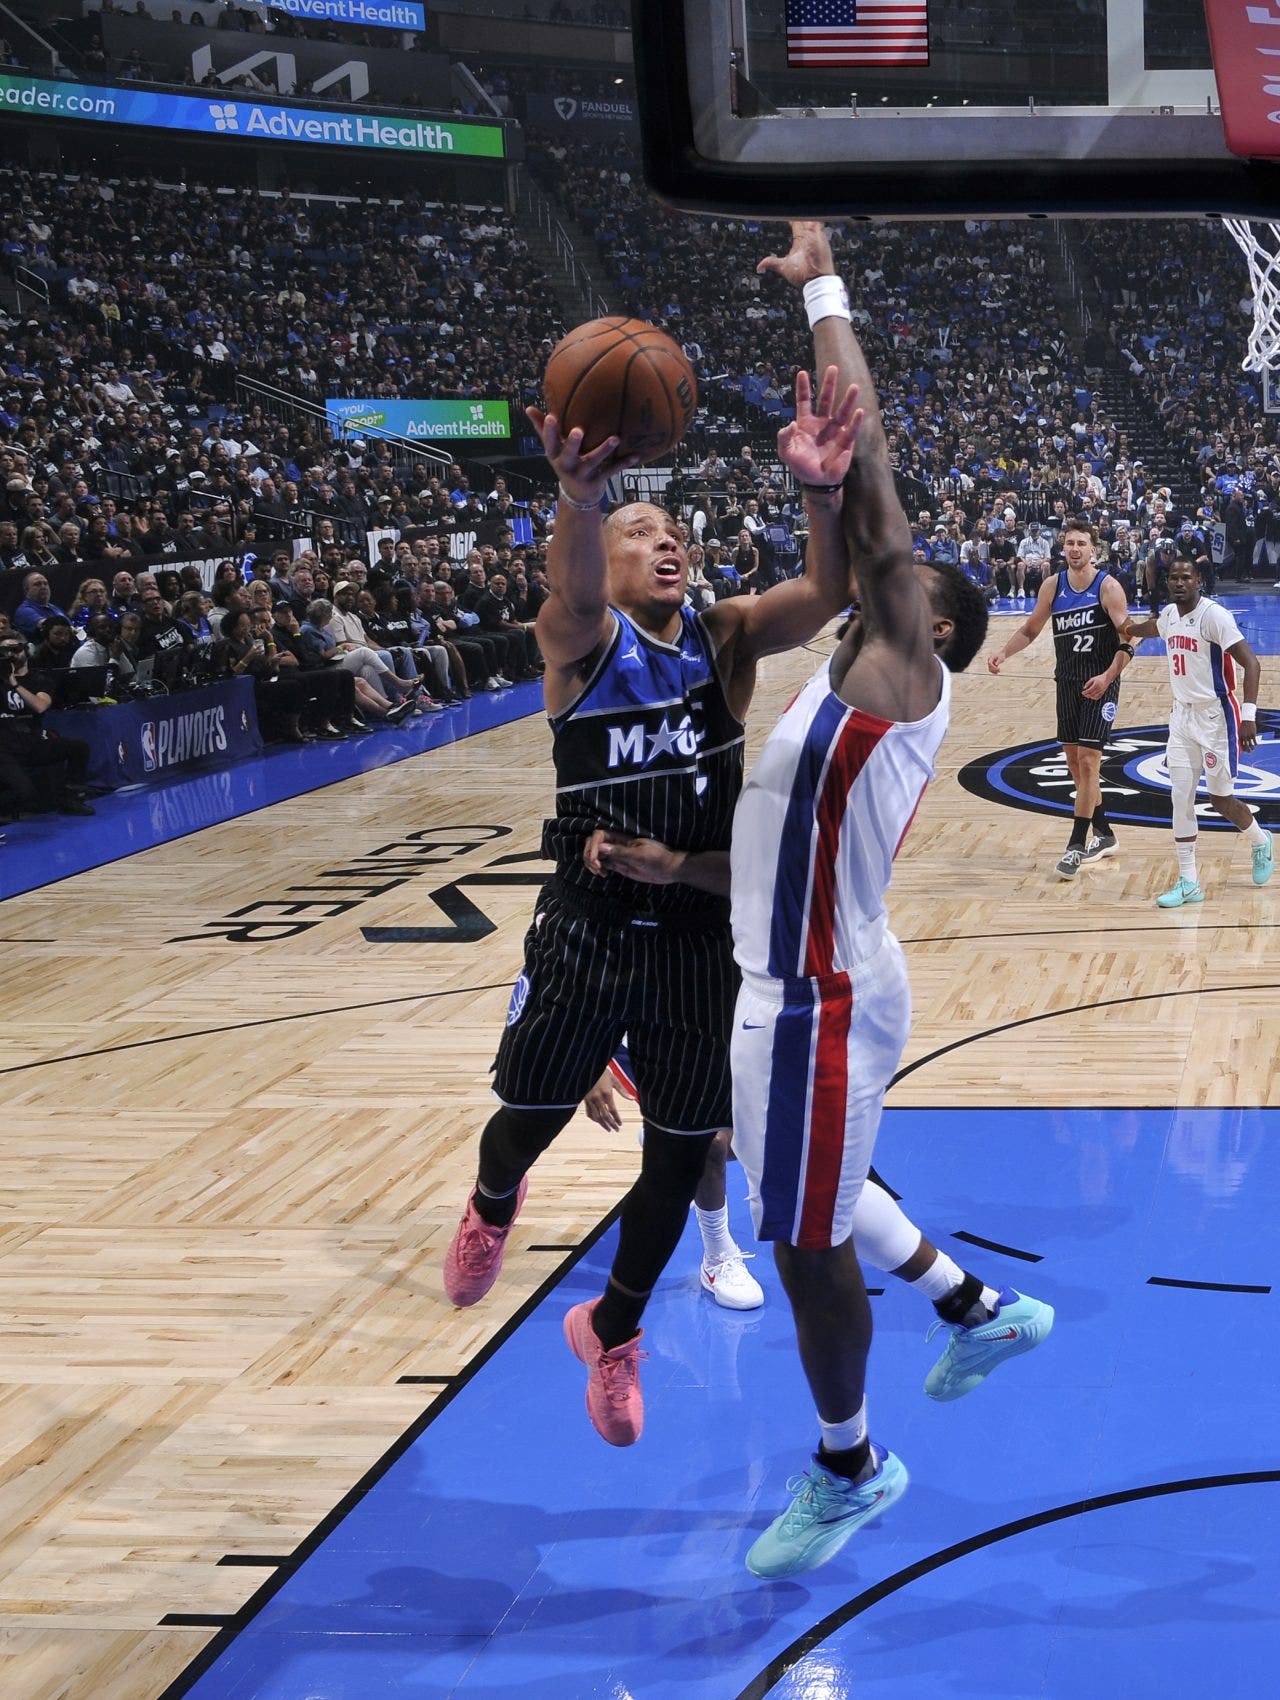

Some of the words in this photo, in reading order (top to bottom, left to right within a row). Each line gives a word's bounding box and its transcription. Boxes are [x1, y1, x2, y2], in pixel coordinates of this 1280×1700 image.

[581, 102, 633, 114] FANDUEL
[247, 108, 454, 150] AdventHealth
[406, 420, 506, 436] AdventHealth
[446, 531, 477, 560] AGIC
[1072, 634, 1095, 653] 22
[1172, 654, 1187, 676] 31
[158, 704, 227, 768] PLAYOFFS
[162, 824, 514, 944] CENTER
